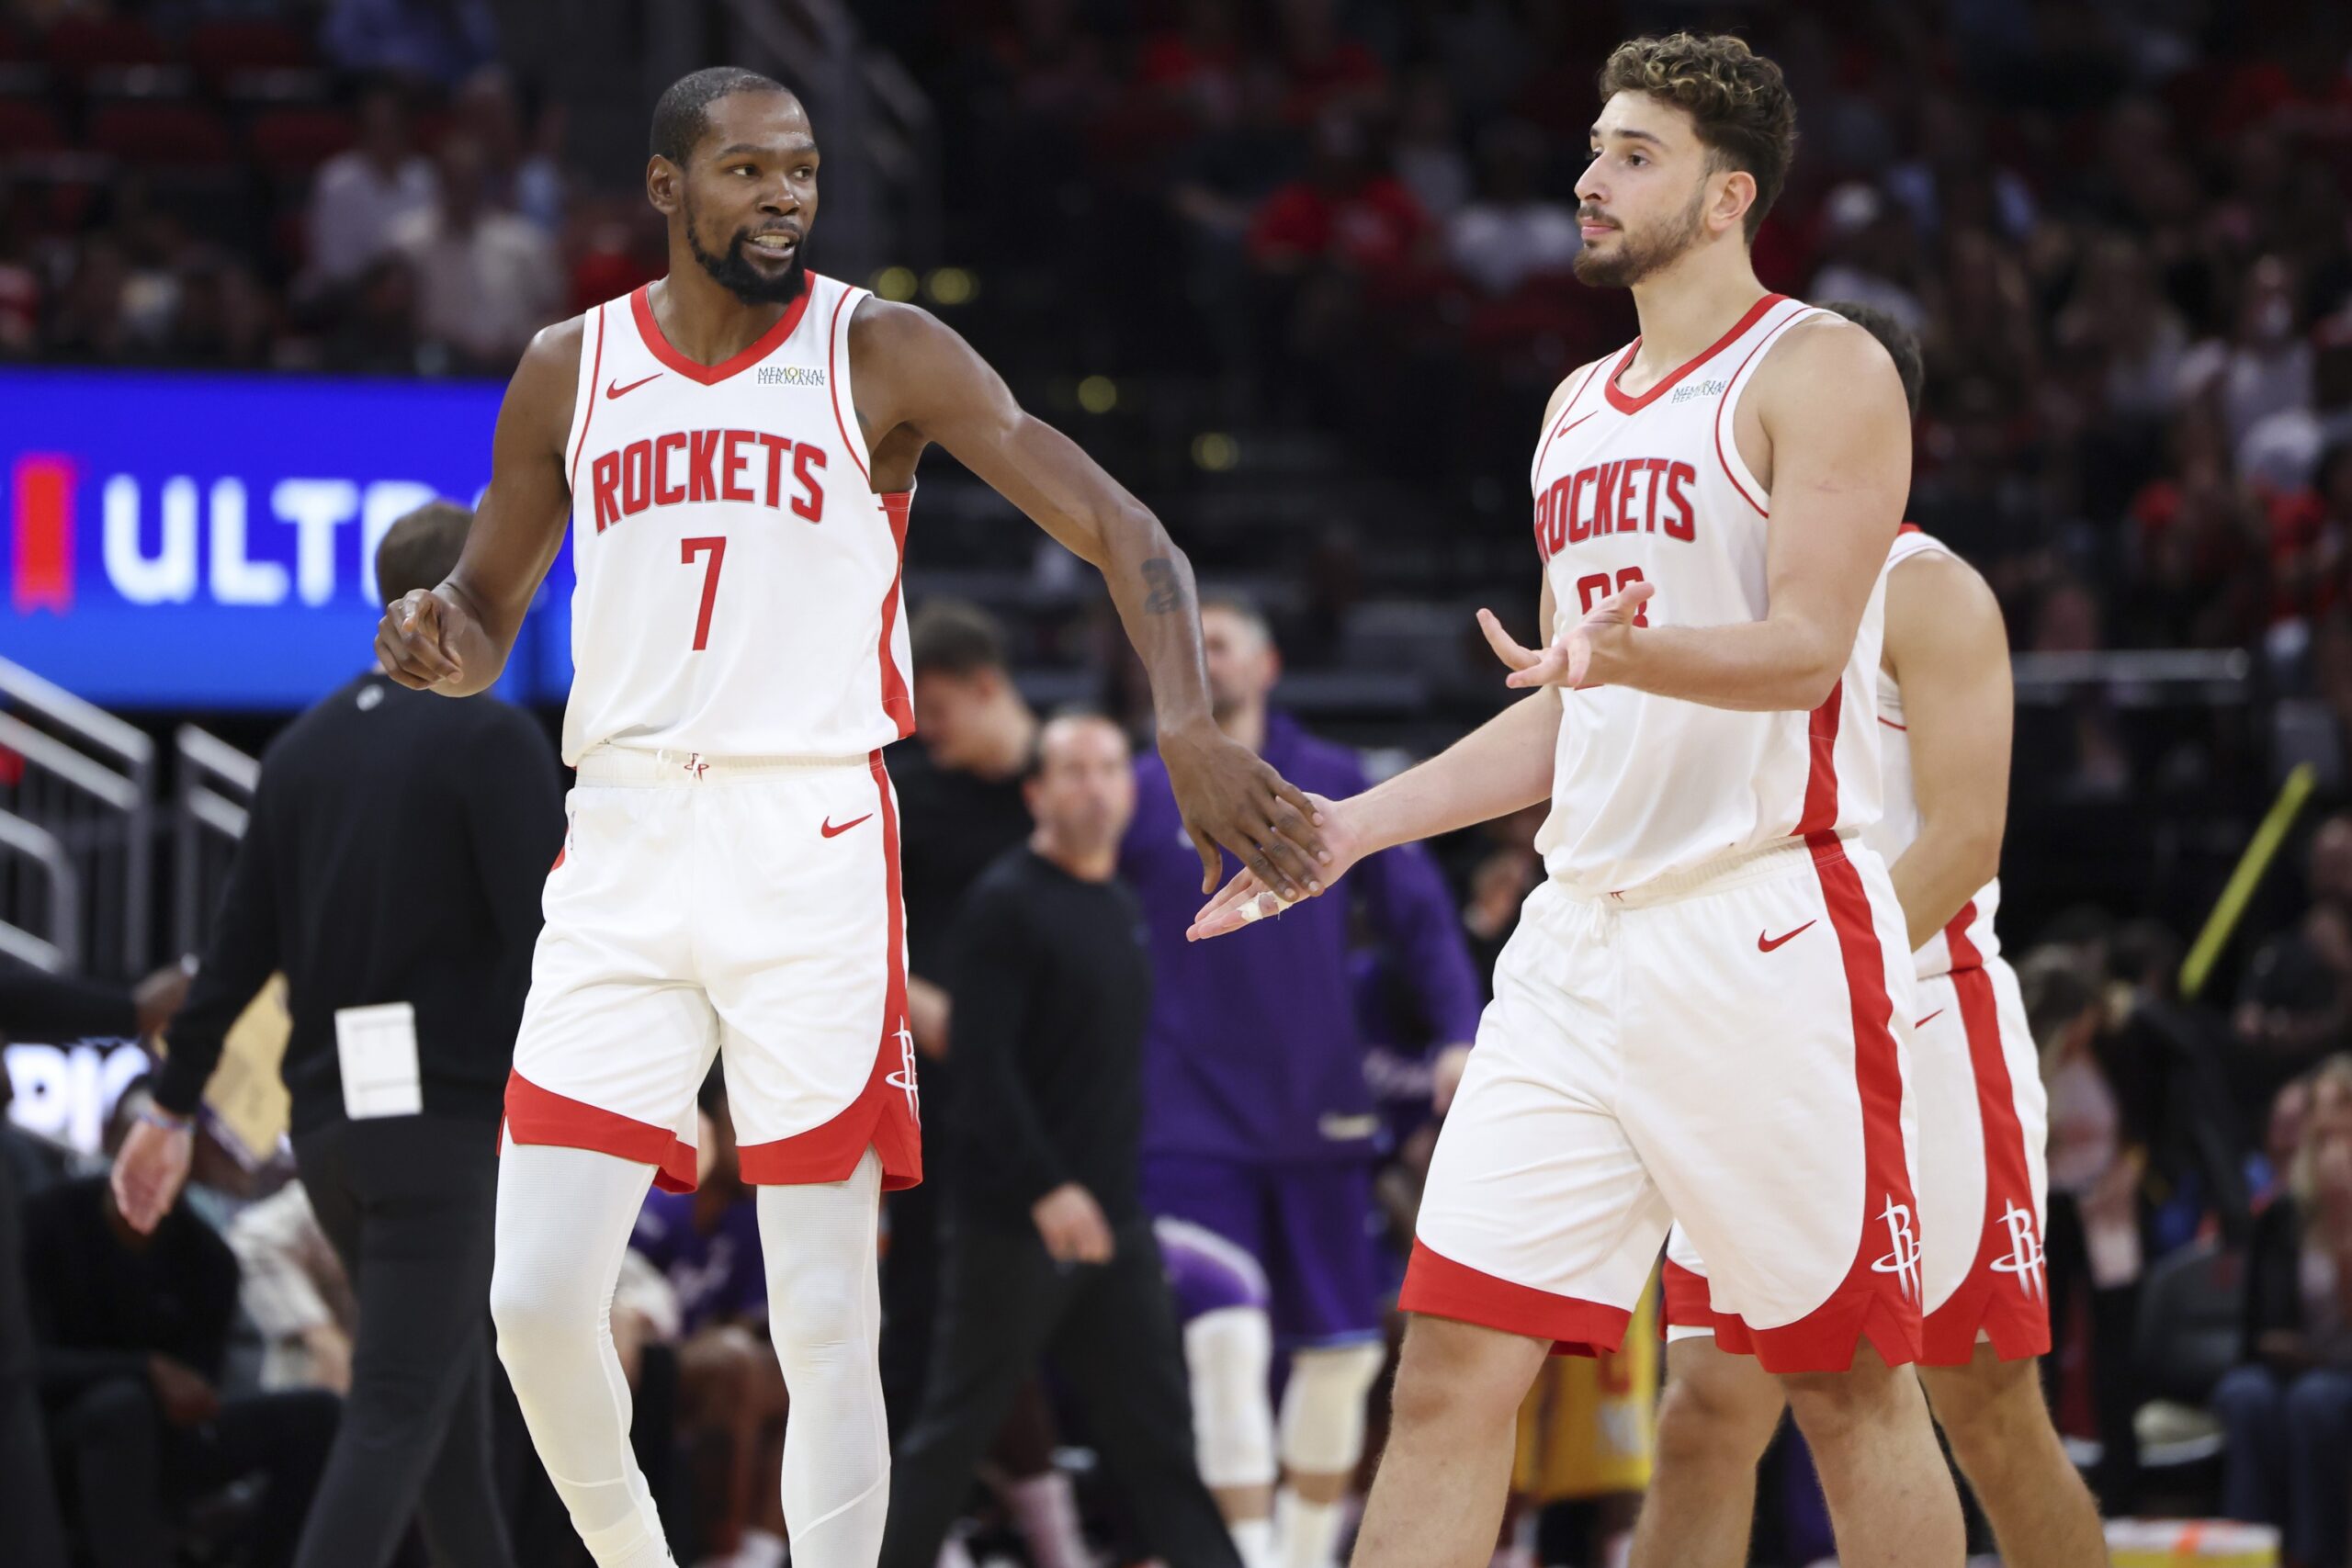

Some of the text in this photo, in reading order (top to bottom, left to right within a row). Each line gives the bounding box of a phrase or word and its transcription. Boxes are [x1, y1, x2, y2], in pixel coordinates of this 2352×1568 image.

[757, 367, 825, 378] MEMORIAL
[757, 374, 825, 386] HERMANN
[592, 428, 828, 536] ROCKETS
[1534, 457, 1696, 566] ROCKETS
[102, 472, 489, 609] ULT
[681, 536, 727, 651] 7
